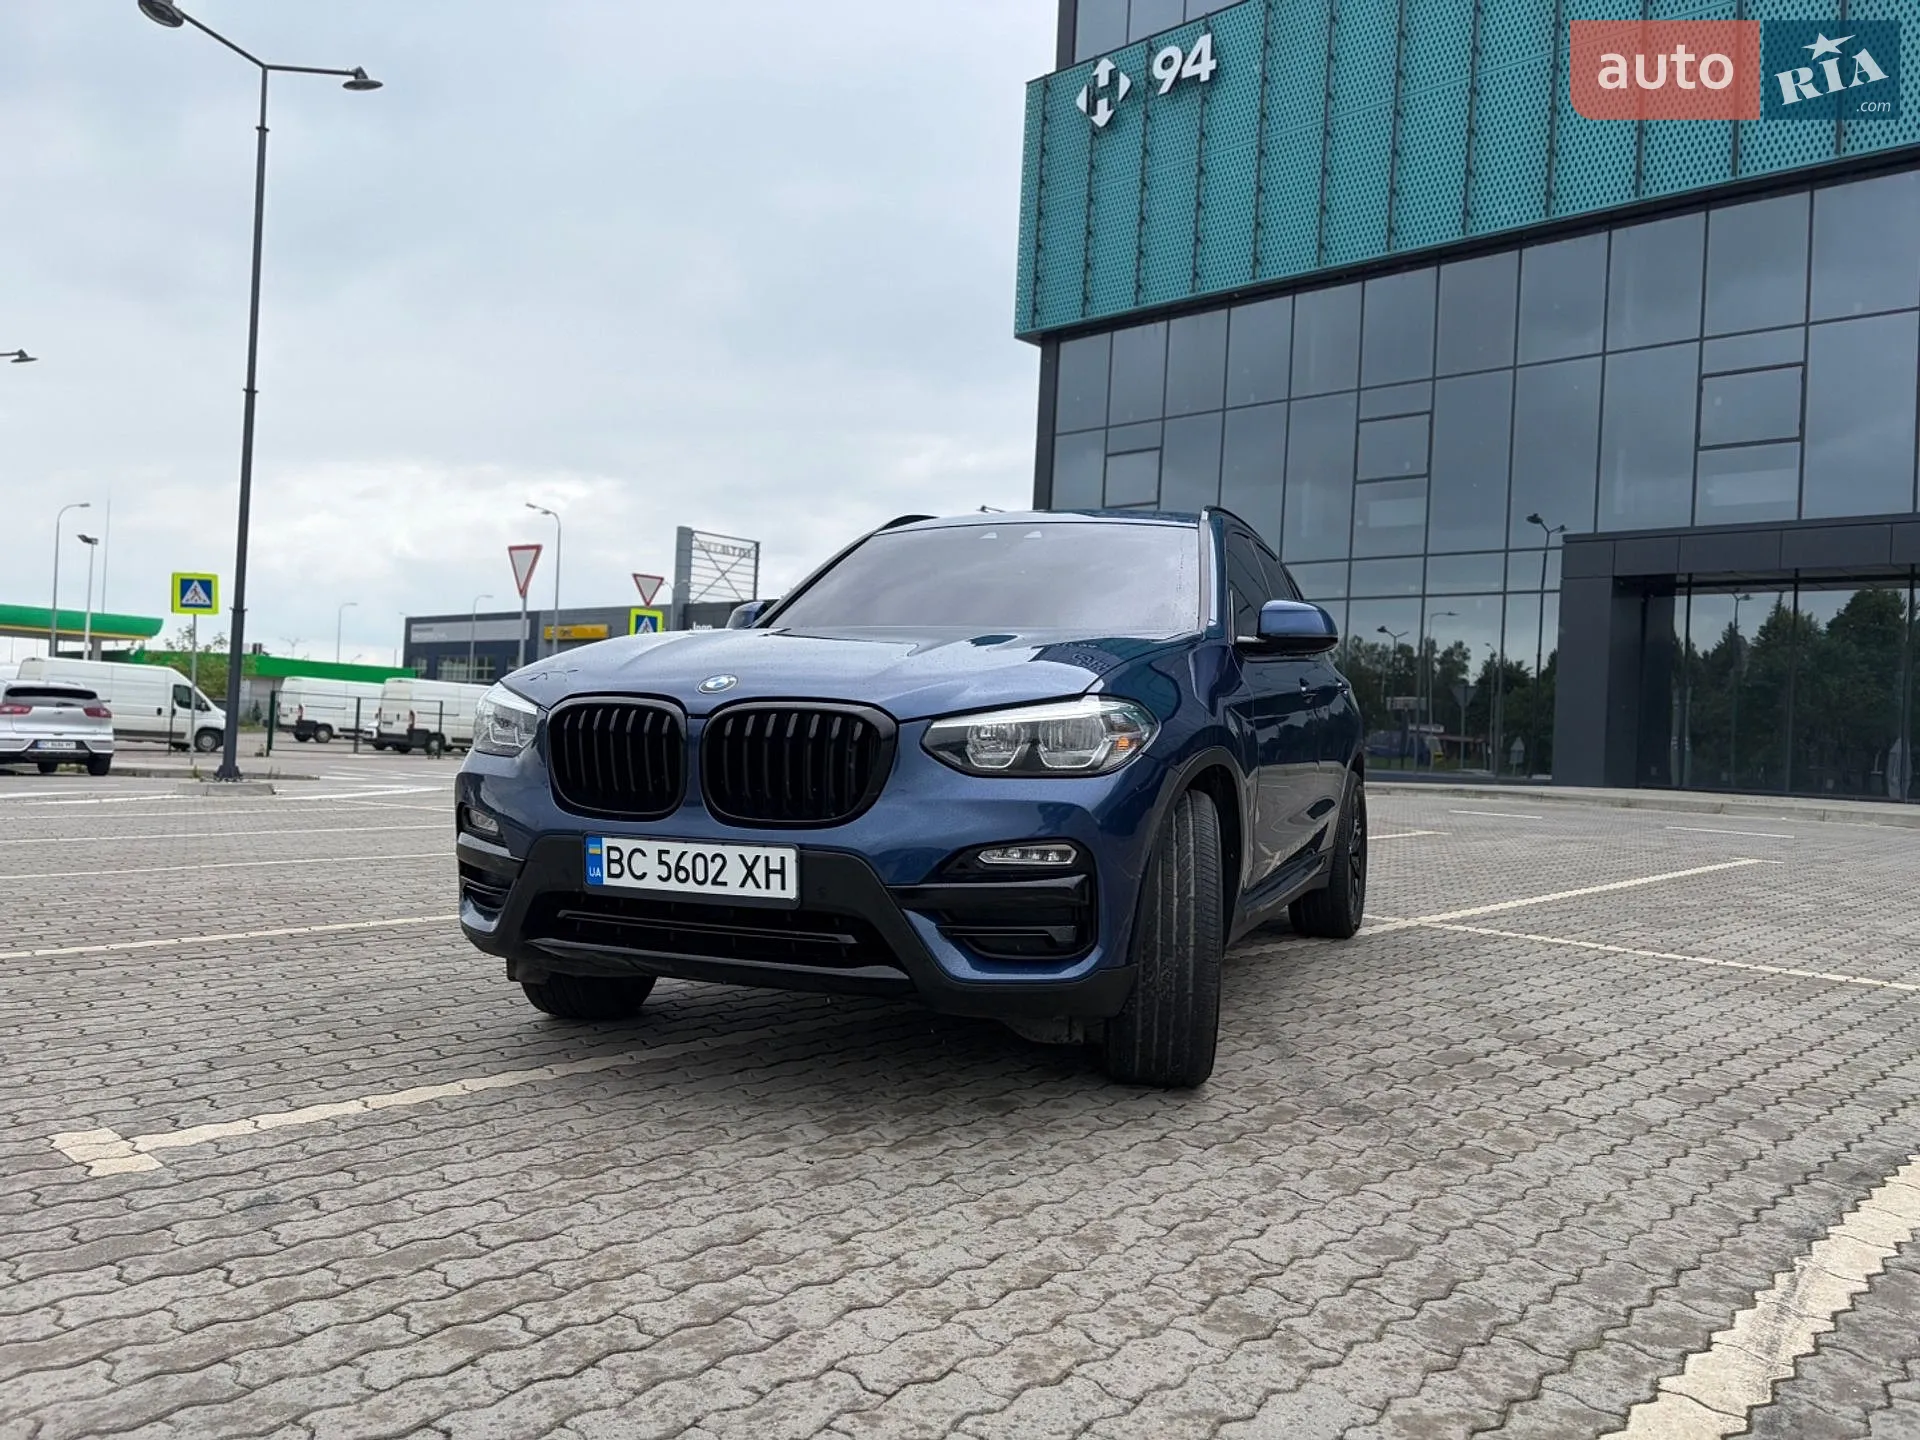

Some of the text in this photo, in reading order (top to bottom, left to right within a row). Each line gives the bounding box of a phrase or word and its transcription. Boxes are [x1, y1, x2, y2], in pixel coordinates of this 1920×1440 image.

[1152, 33, 1217, 96] 94
[589, 867, 602, 877] UA
[606, 846, 787, 891] BC 5602 XH
